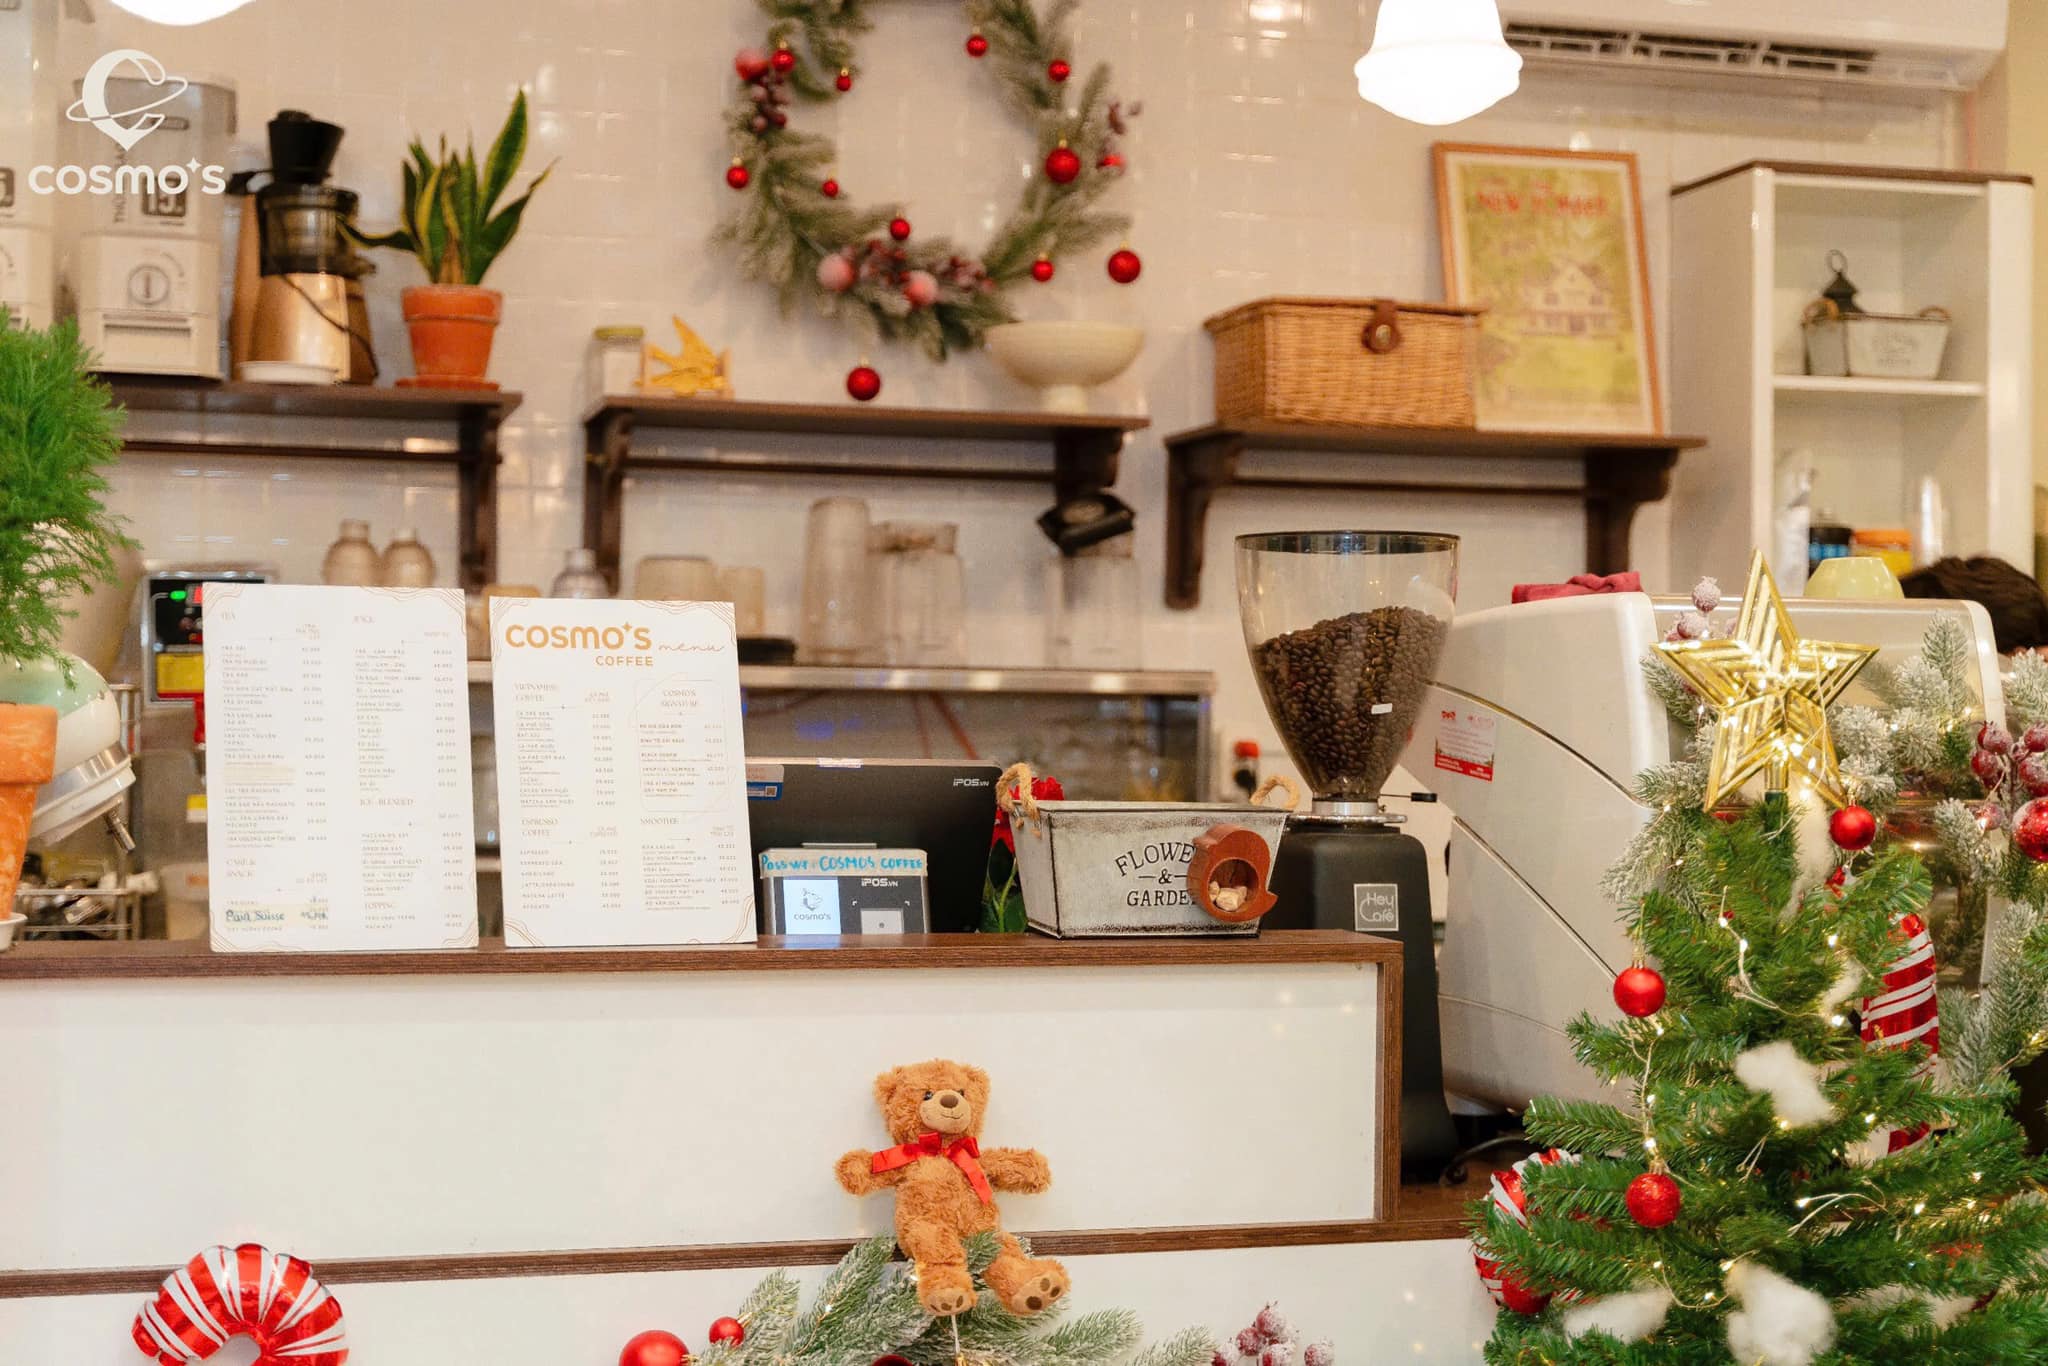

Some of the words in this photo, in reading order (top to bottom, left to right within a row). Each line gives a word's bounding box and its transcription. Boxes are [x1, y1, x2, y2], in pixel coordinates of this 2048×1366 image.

[595, 655, 654, 668] COFFEE
[1115, 842, 1196, 877] FLOWE
[1158, 868, 1172, 885] &
[1126, 889, 1196, 907] GARDE
[1366, 892, 1395, 909] Hey
